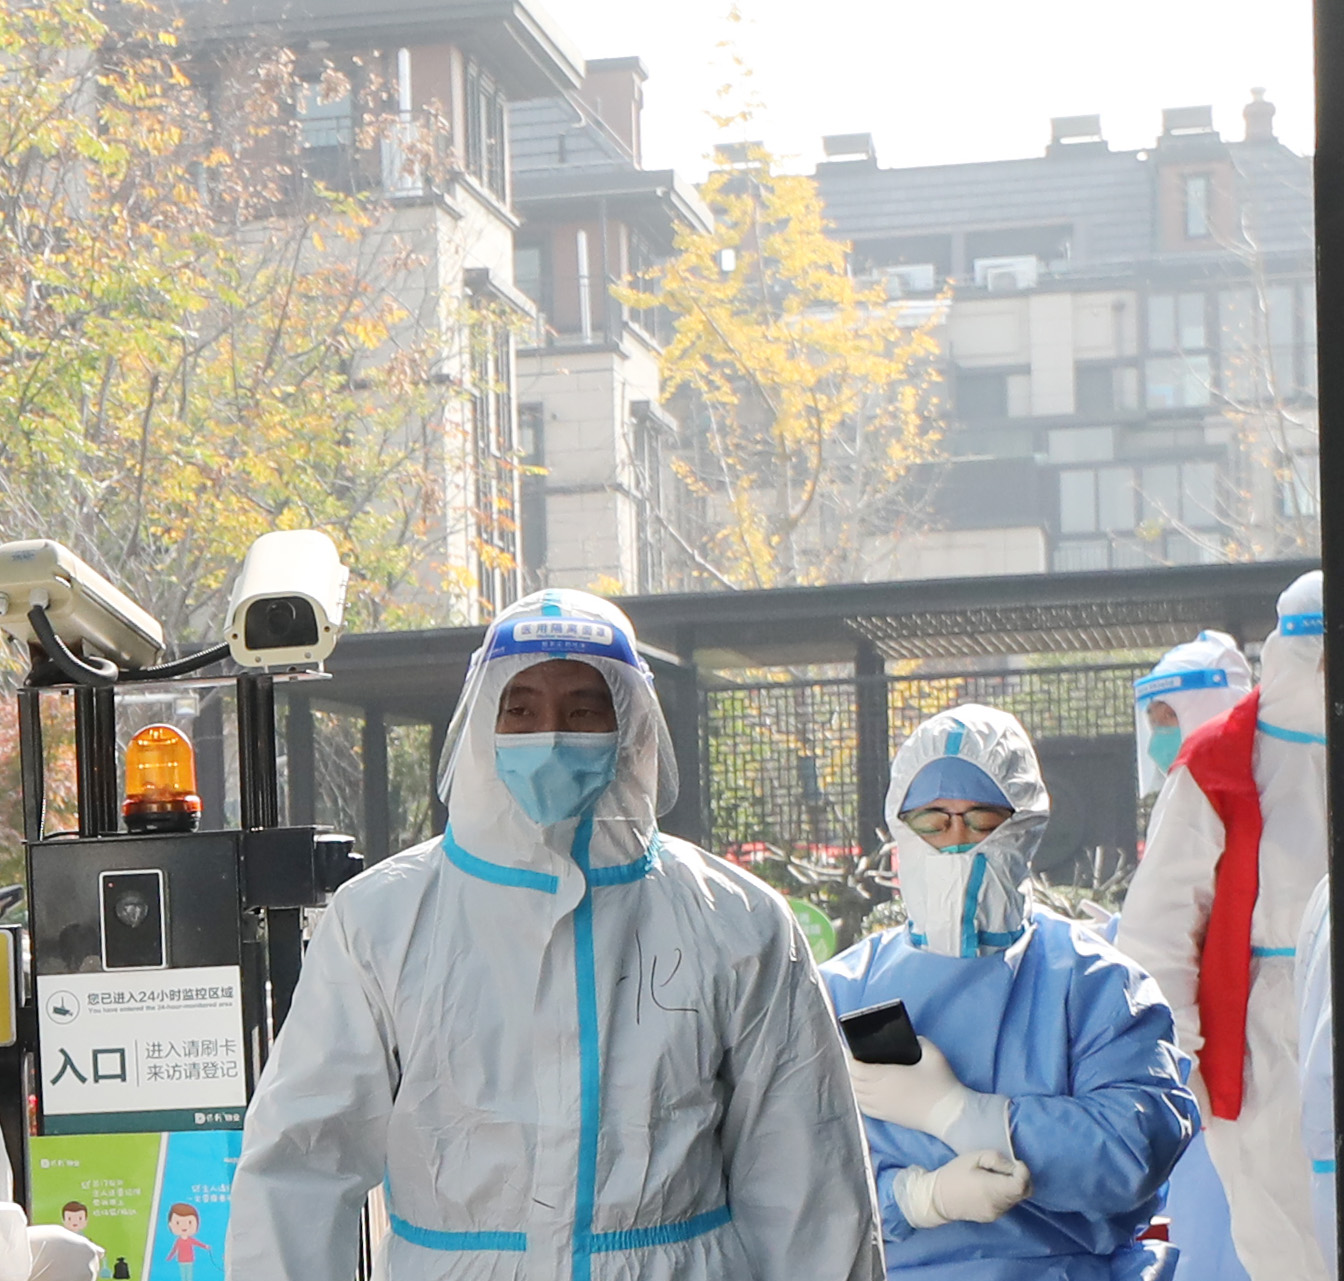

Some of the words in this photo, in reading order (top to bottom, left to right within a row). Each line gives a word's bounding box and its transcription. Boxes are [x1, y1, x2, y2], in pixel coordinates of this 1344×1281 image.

[87, 986, 234, 1006] 您已进入24小时监控区域
[145, 1037, 237, 1060] 进入请刷卡
[50, 1047, 127, 1086] 入口
[146, 1060, 238, 1082] 来访请登记
